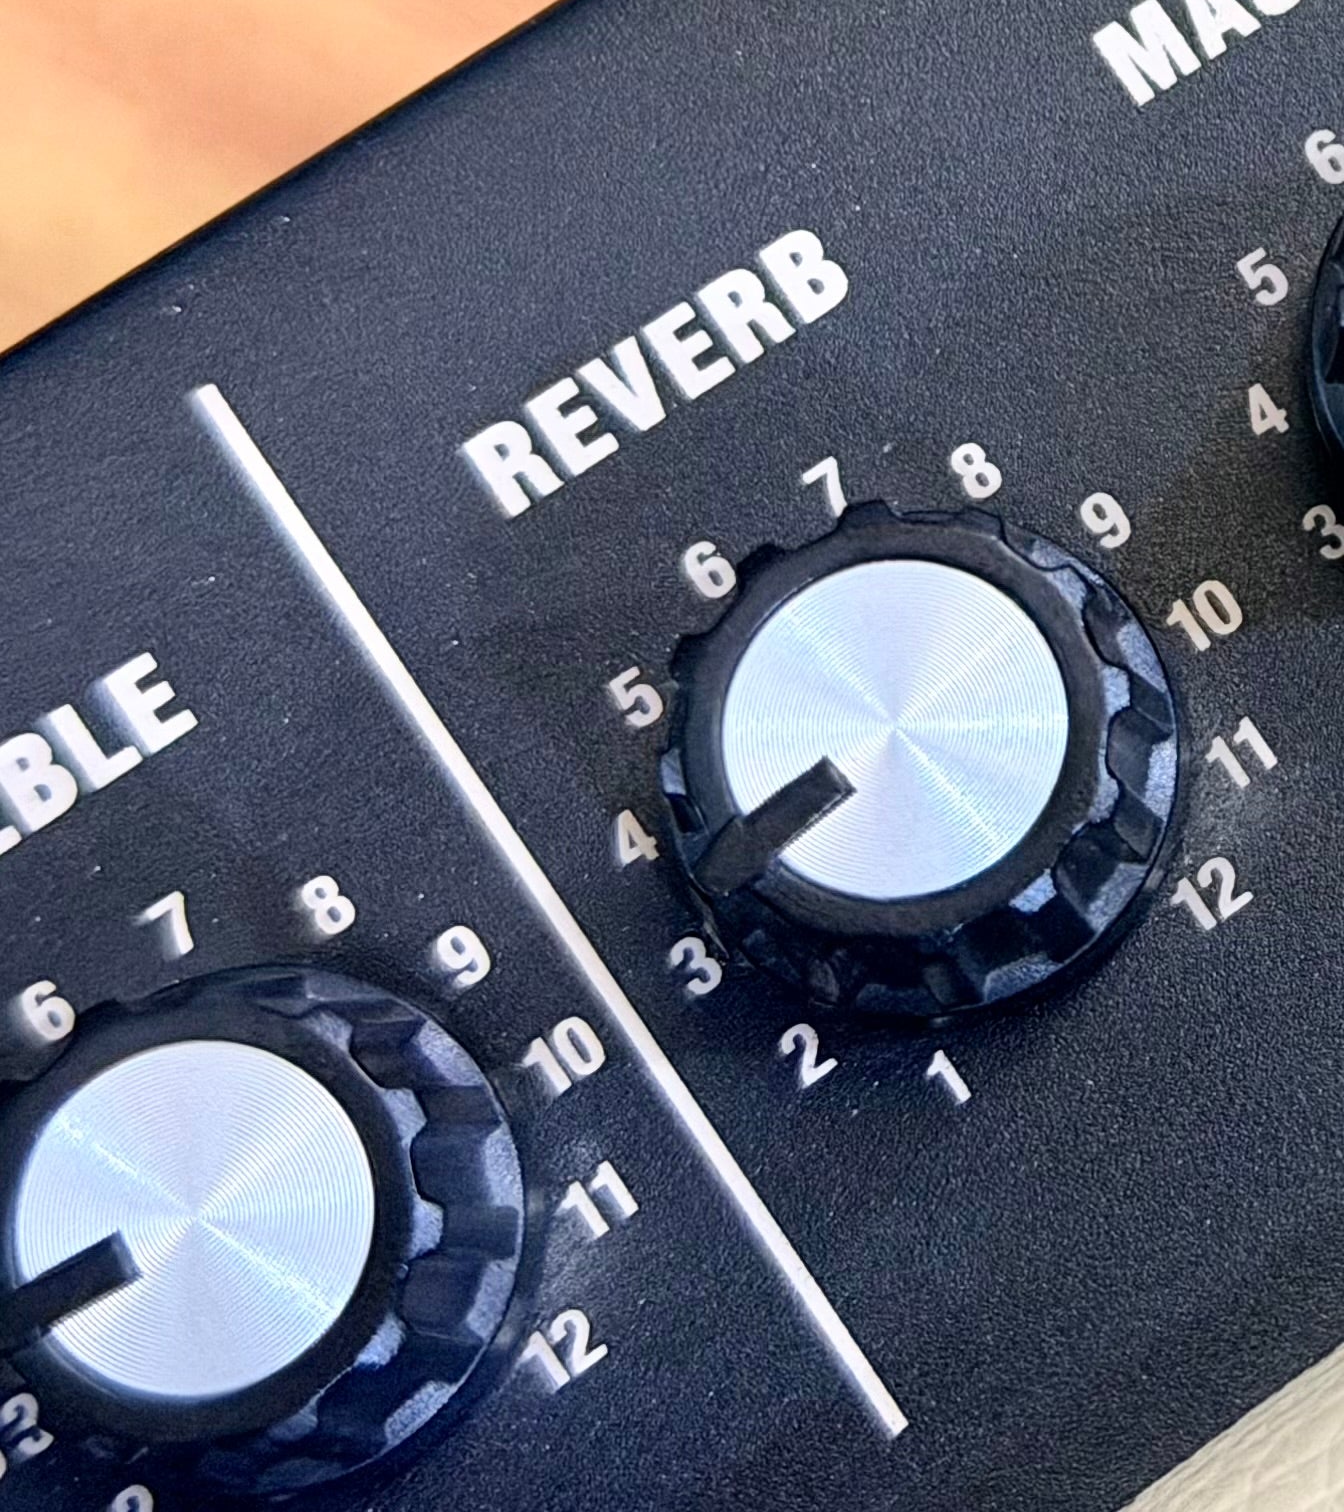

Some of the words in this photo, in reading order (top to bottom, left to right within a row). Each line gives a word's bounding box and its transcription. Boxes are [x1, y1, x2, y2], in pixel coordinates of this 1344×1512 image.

[1236, 248, 1290, 306] 5
[462, 229, 850, 519] REVERB
[1246, 382, 1288, 438] 4
[801, 456, 848, 517] 7
[950, 442, 1003, 499] 8
[1079, 491, 1133, 548] 9
[684, 540, 737, 599] 6
[1166, 579, 1244, 652] 10
[607, 667, 665, 728] 5
[0, 651, 199, 856] BLE
[1204, 716, 1280, 788] 11
[612, 808, 658, 866] 4
[138, 890, 195, 958] 7
[298, 875, 356, 936] 8
[1170, 856, 1254, 931] 12
[434, 925, 492, 988] 9
[668, 935, 723, 997] 3
[20, 980, 76, 1043] 6
[520, 1016, 606, 1092] 10
[777, 1023, 838, 1088] 2
[924, 1050, 972, 1105] 1
[556, 1161, 640, 1239] 11
[520, 1308, 609, 1392] 12
